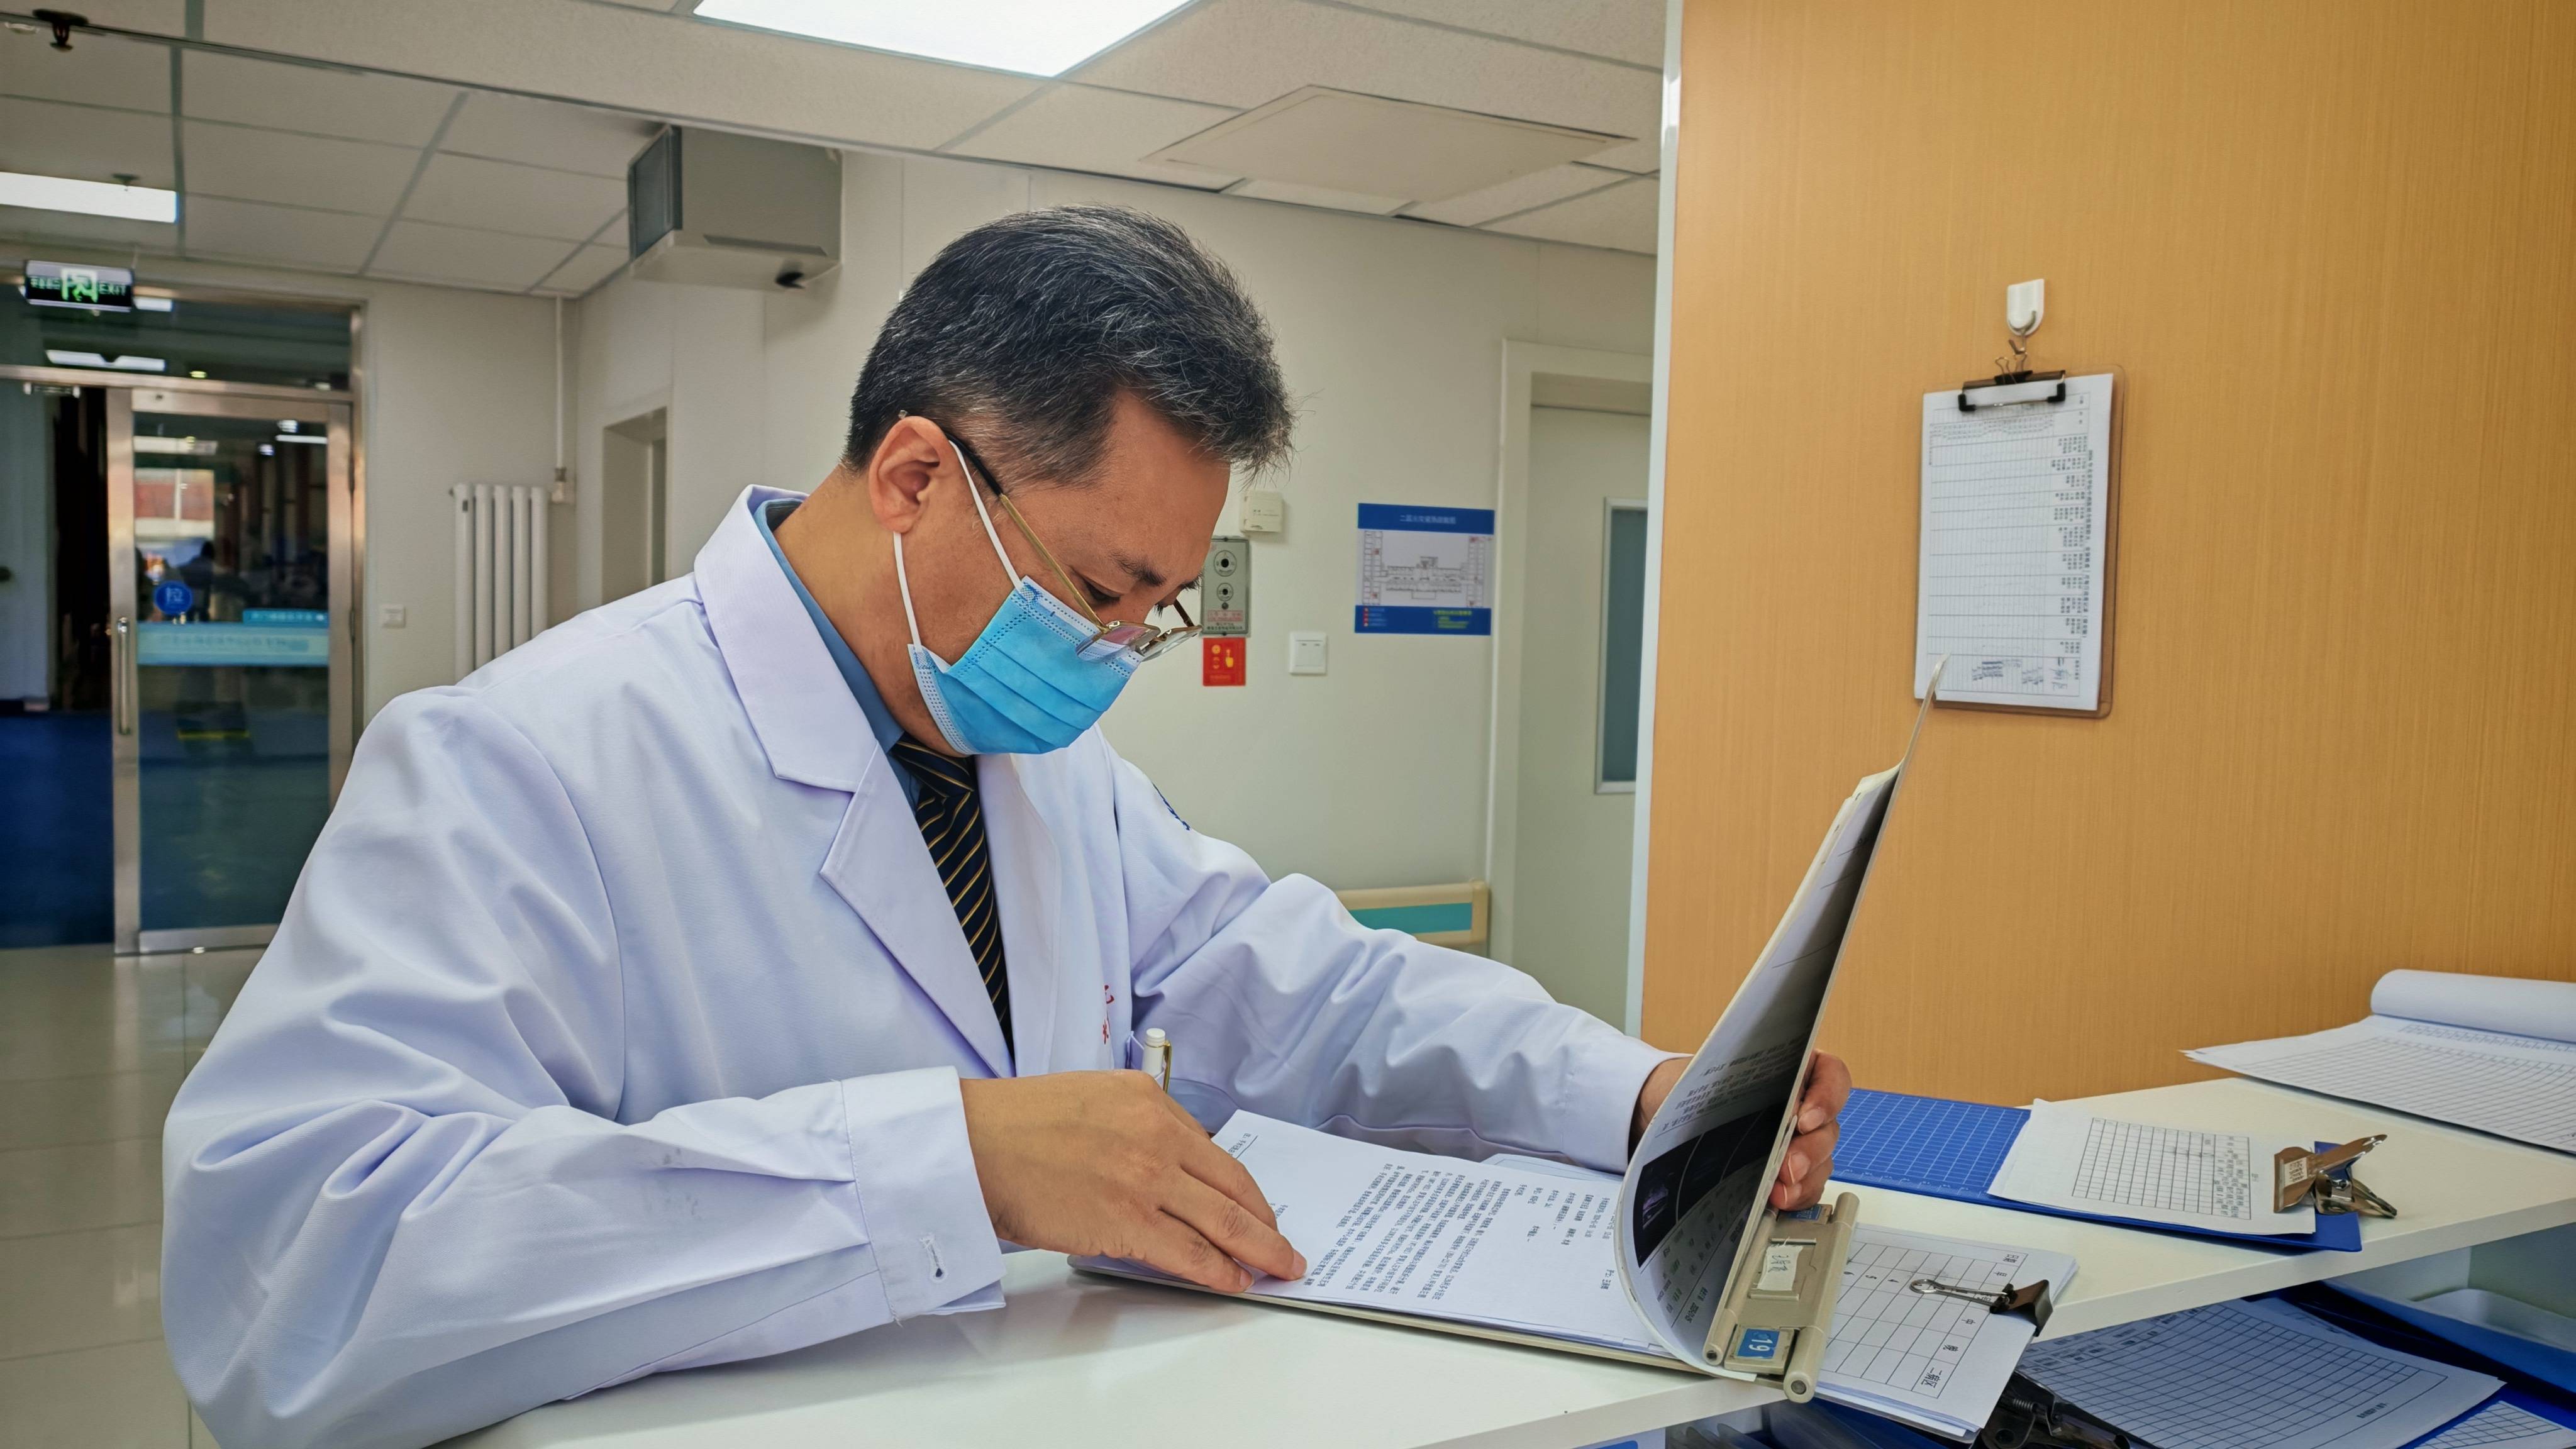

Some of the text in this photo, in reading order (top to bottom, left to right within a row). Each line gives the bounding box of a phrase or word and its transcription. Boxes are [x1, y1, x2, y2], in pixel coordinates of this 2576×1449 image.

[99, 282, 127, 296] EXIT
[2002, 1253, 2019, 1264] 日期
[1961, 1318, 1976, 1326] 中
[1749, 1338, 1774, 1352] 19
[1942, 1344, 1959, 1353] 晚
[1921, 1367, 1943, 1389] 二病区
